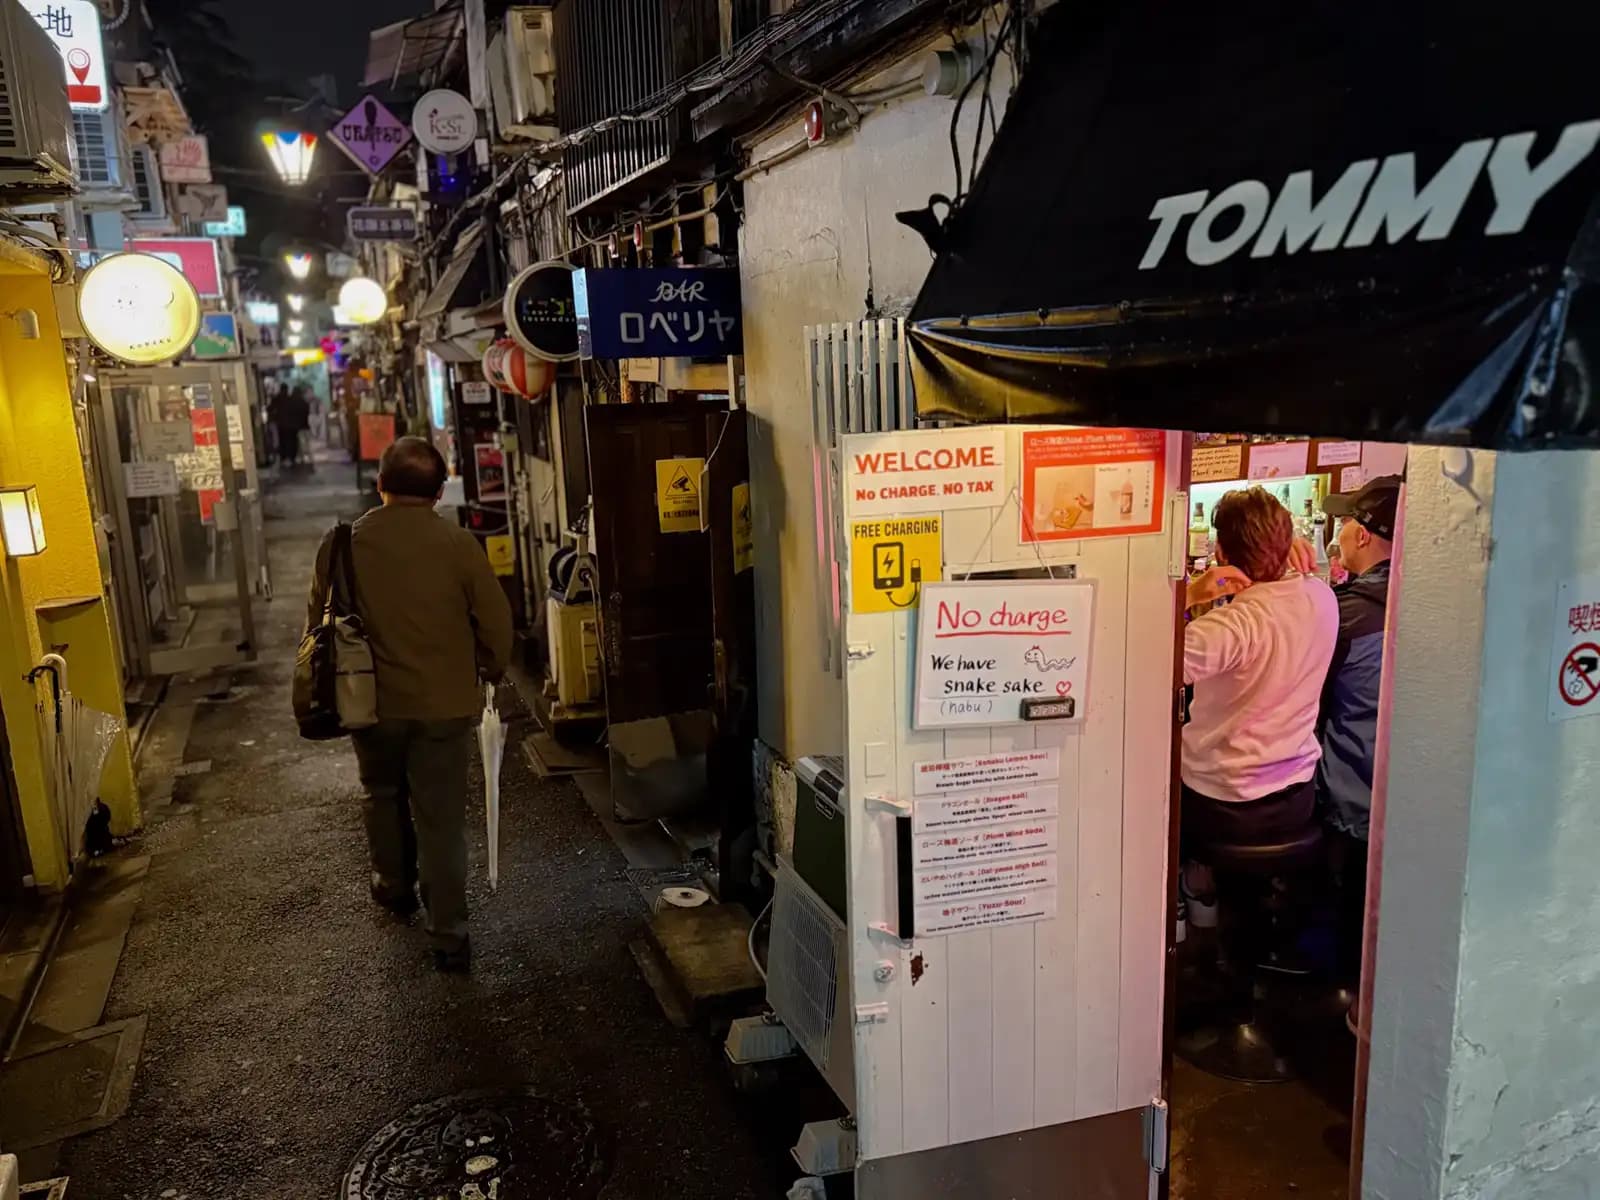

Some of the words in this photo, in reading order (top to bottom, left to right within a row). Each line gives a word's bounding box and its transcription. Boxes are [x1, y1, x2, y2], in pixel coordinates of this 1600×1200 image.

[1138, 119, 1600, 270] TOMMY
[649, 279, 708, 302] BAR
[620, 310, 735, 343] ロベリヤ
[855, 446, 995, 474] WELCOME
[943, 482, 963, 495] NO
[967, 481, 994, 493] TAX
[854, 523, 881, 538] FREE
[884, 520, 938, 537] CHARGING
[937, 601, 981, 629] No
[989, 601, 1068, 631] charge
[931, 654, 954, 671] We
[957, 654, 997, 672] have
[944, 678, 996, 694] snake
[1002, 678, 1046, 694] sake
